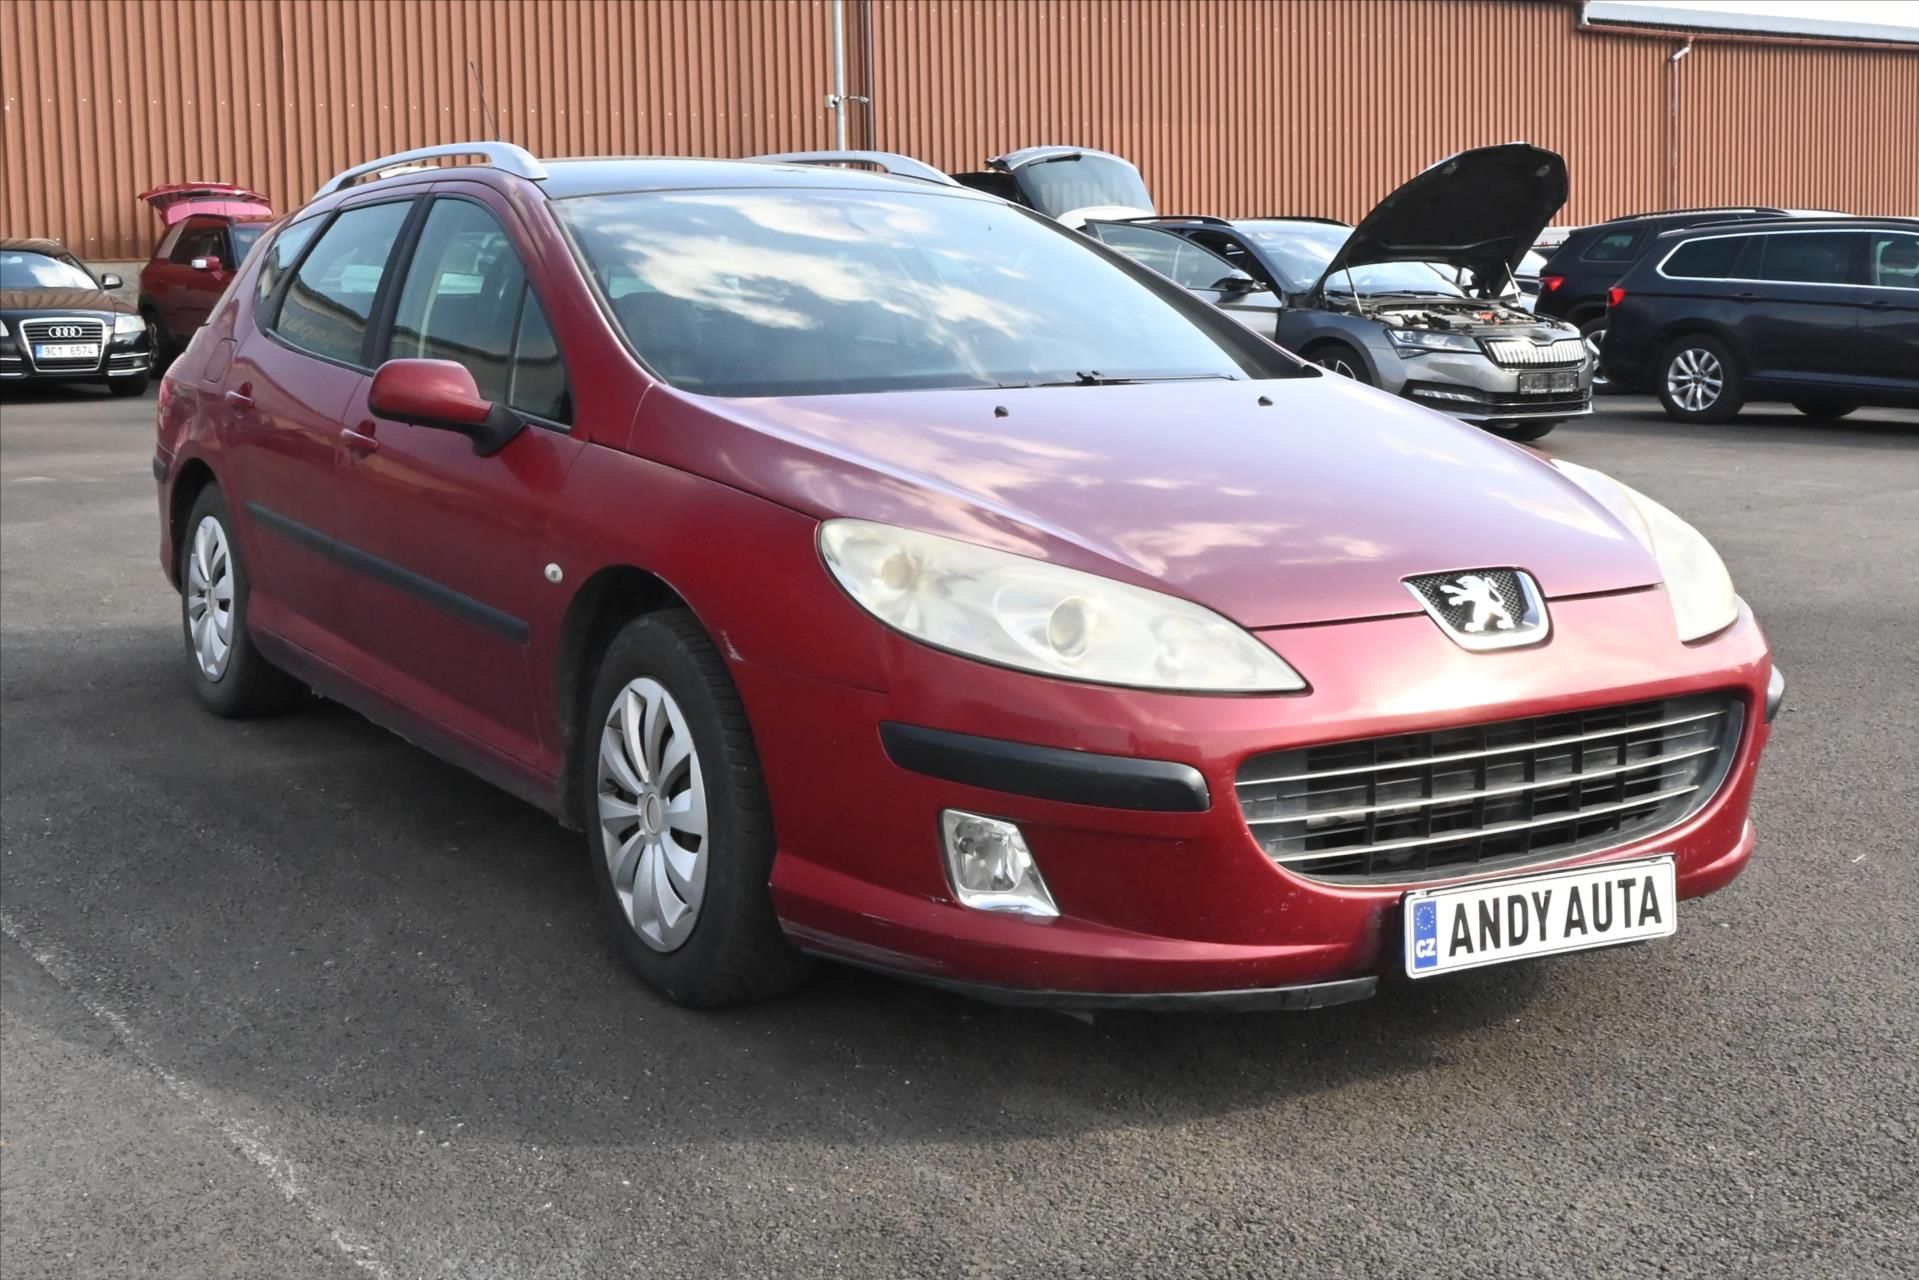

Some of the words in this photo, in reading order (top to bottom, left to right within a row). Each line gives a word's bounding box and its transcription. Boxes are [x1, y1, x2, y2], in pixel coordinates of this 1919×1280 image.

[1448, 889, 1553, 957] ANDY
[1563, 875, 1663, 938] AUTA
[1415, 937, 1436, 958] CZ
